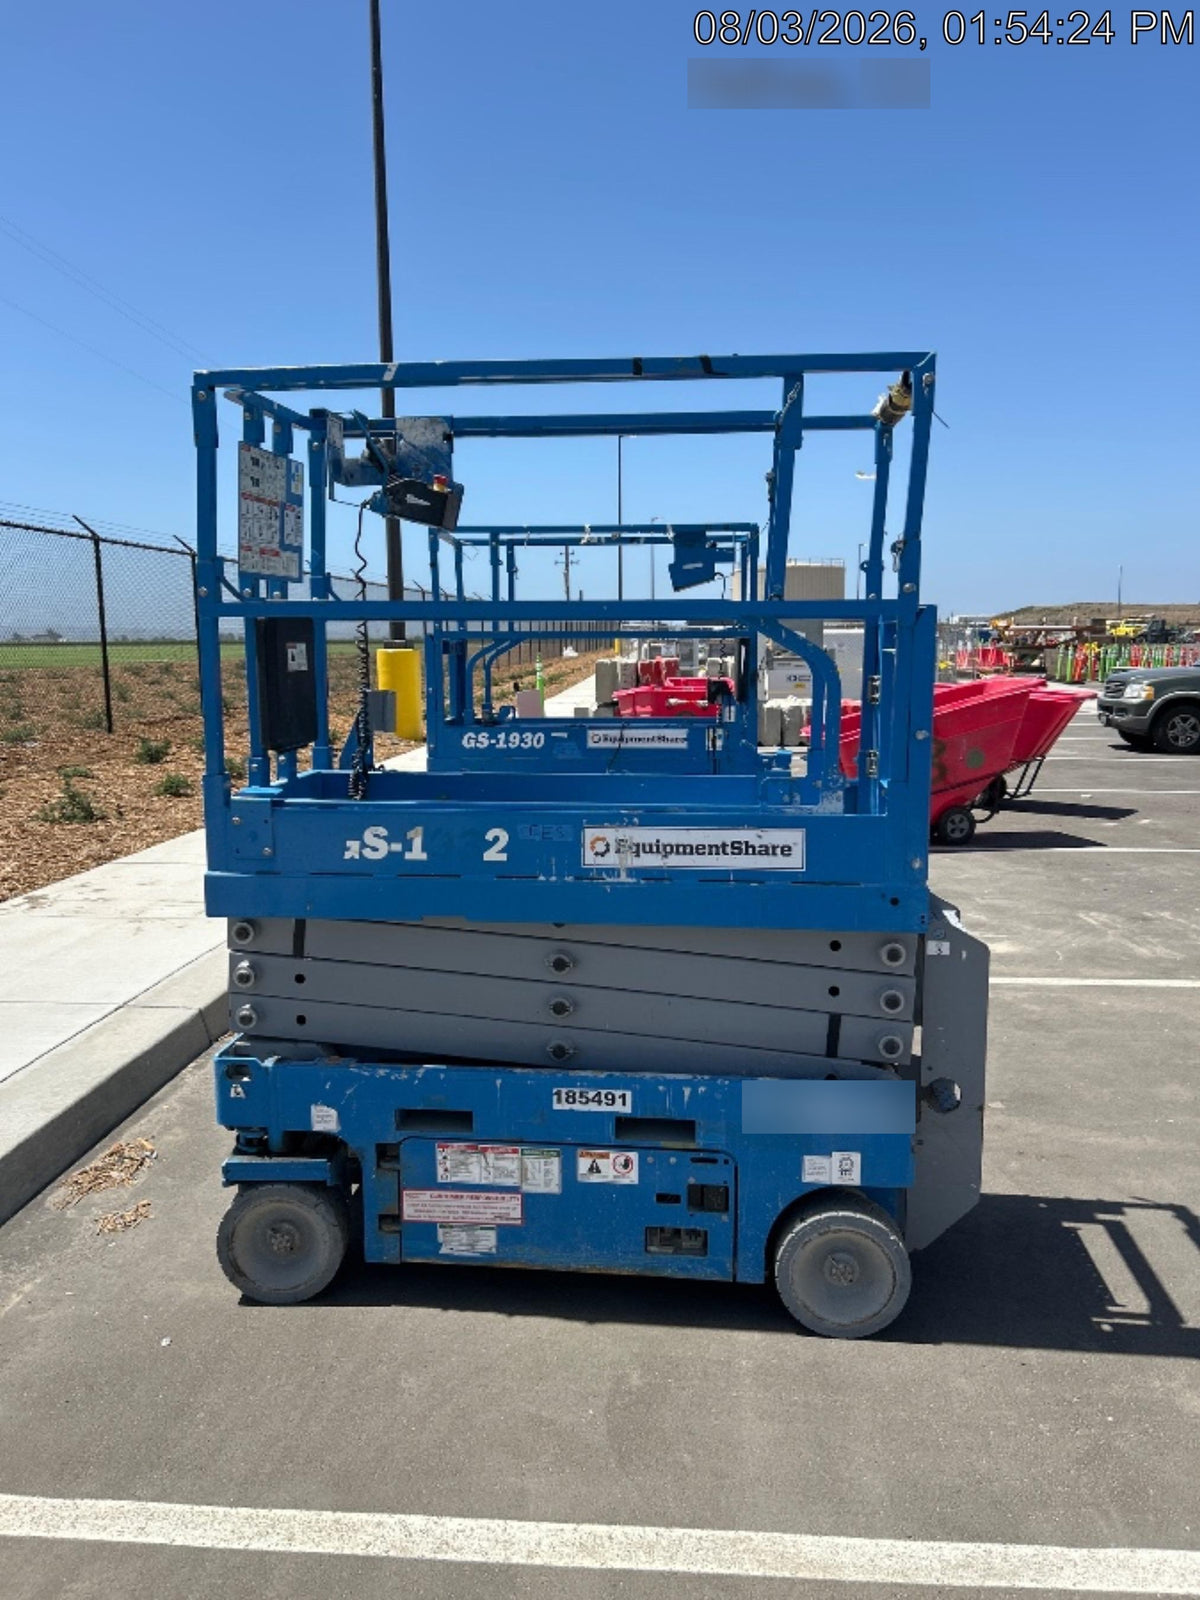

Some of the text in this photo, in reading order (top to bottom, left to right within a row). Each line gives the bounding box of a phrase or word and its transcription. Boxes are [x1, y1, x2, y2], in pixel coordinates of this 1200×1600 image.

[461, 732, 545, 749] GS-1930
[614, 838, 793, 859] EquipmentShare
[553, 1089, 627, 1107] 185491
